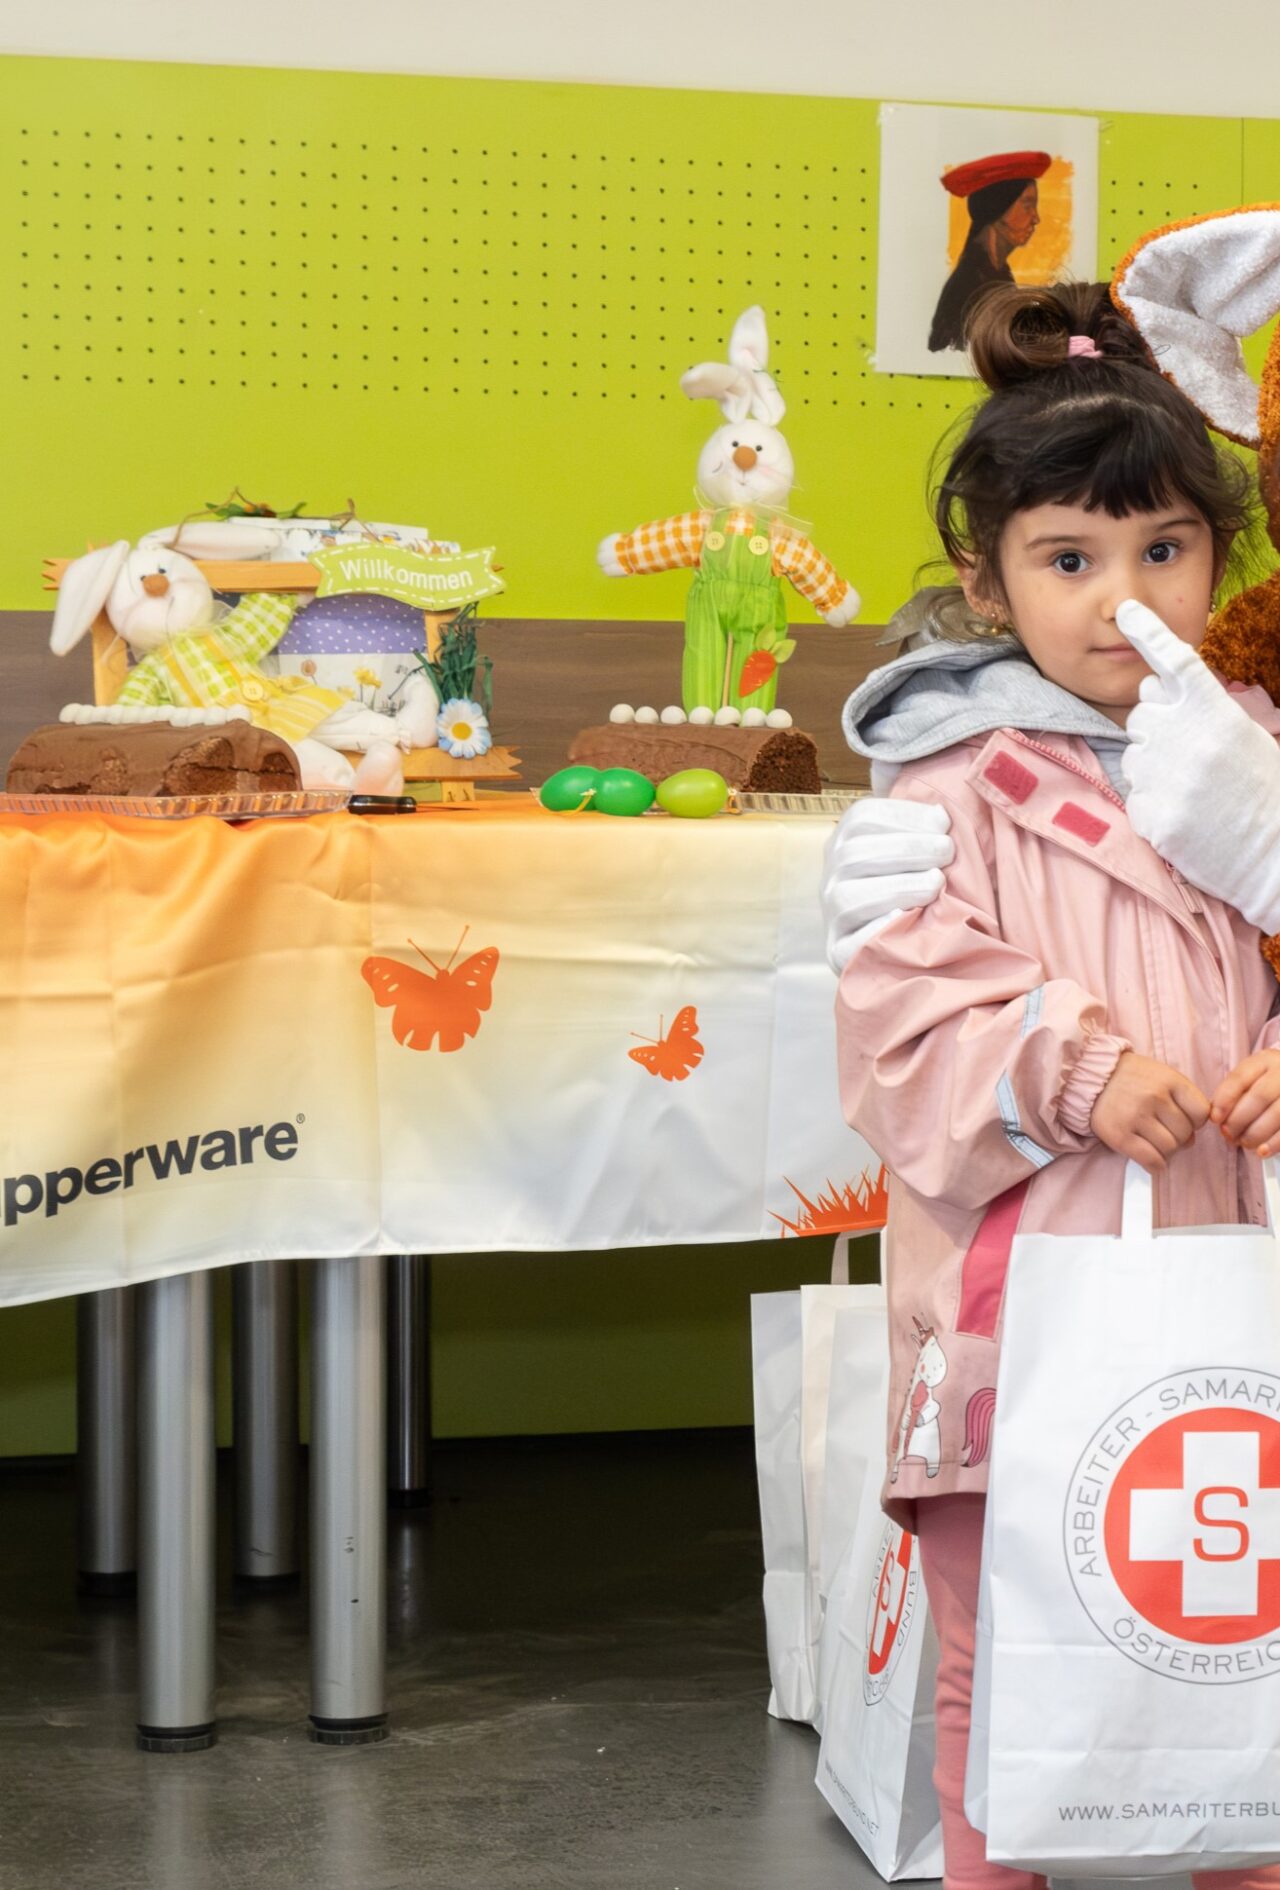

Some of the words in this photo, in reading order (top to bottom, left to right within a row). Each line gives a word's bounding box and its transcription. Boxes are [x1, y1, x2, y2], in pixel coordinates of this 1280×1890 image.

[340, 559, 473, 591] Willkommen
[0, 1121, 299, 1227] pperware
[1073, 1415, 1141, 1578] ARBEITER
[1193, 1486, 1250, 1562] S
